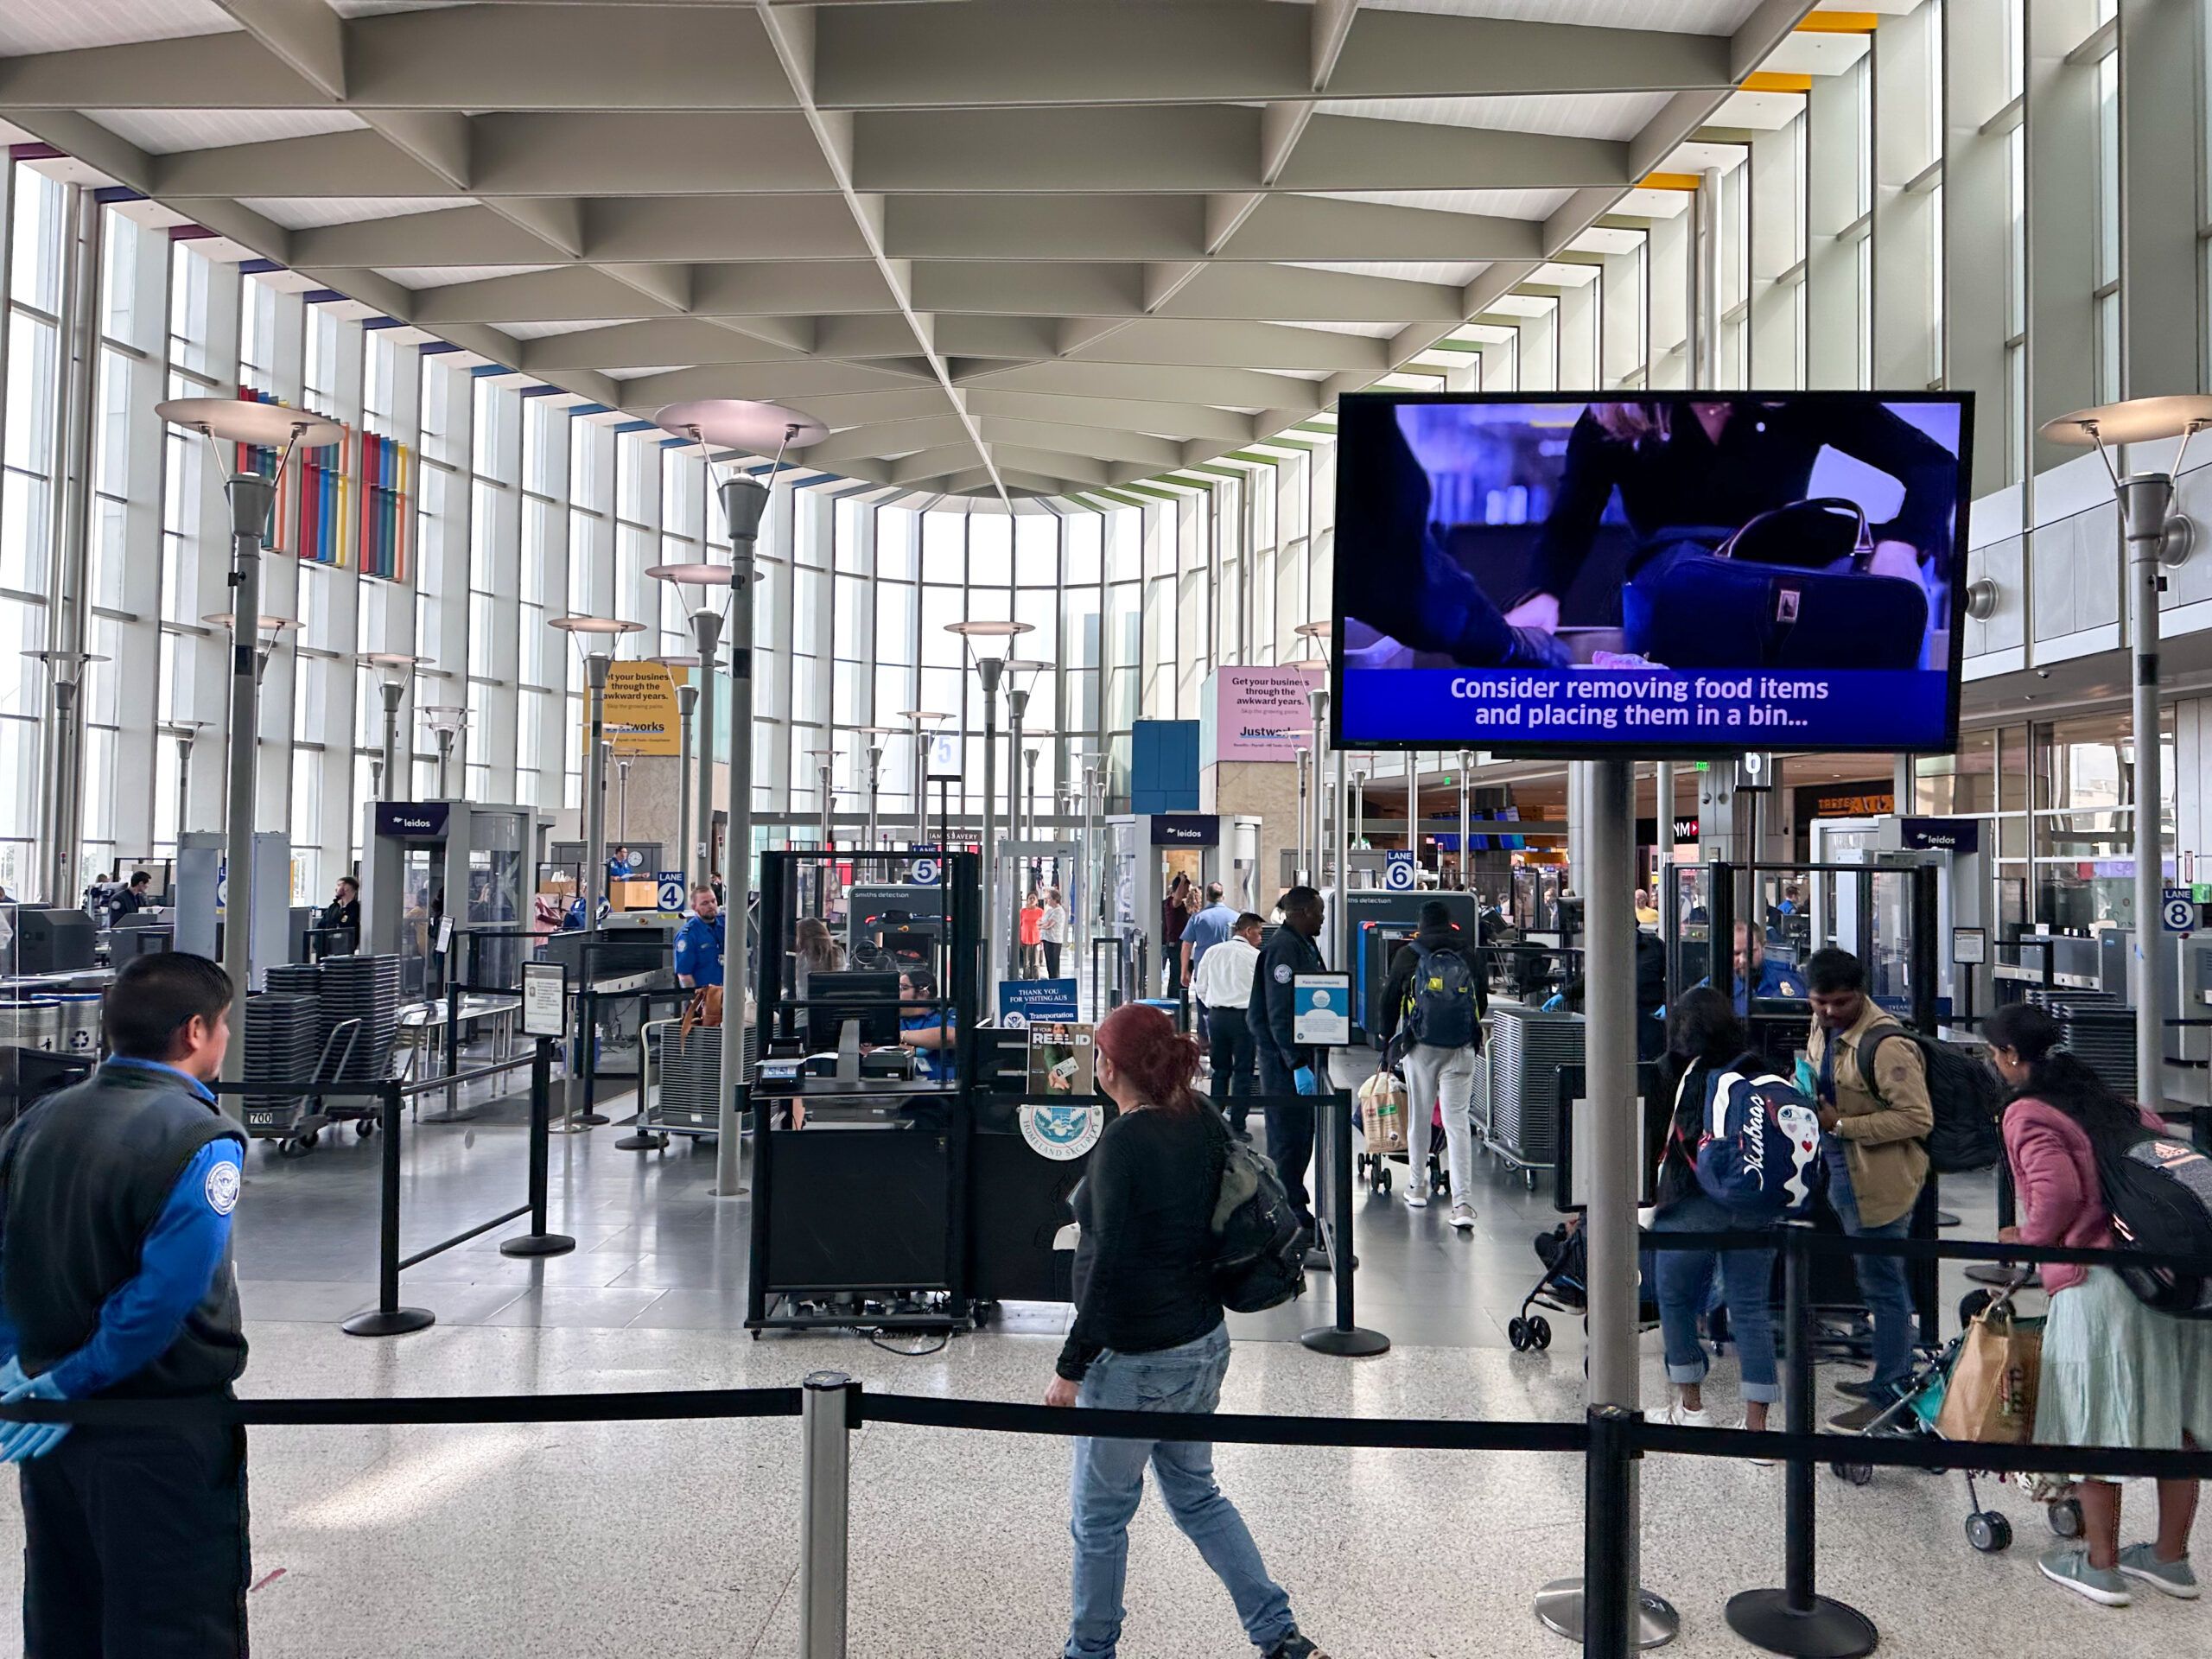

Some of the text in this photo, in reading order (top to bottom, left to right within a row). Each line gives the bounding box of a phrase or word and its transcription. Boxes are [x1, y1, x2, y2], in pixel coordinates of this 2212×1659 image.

[612, 683, 645, 691] through
[1245, 688, 1280, 696] through
[1451, 677, 1828, 702] Consider removing food items
[1475, 703, 1808, 728] and placing them in a bin...
[938, 735, 951, 764] 5
[404, 818, 431, 827] leidos
[1928, 834, 1955, 844] leidos
[659, 873, 683, 881] LANE
[918, 861, 932, 880] 5
[1392, 864, 1408, 886] 6
[662, 886, 677, 906] 4
[2164, 890, 2191, 899] LANE
[2171, 904, 2188, 925] 8
[1029, 1011, 1074, 1020] Transportation
[1033, 1033, 1091, 1046] REAL ID
[251, 1113, 271, 1123] 700
[1023, 1120, 1063, 1157] HOMELAND
